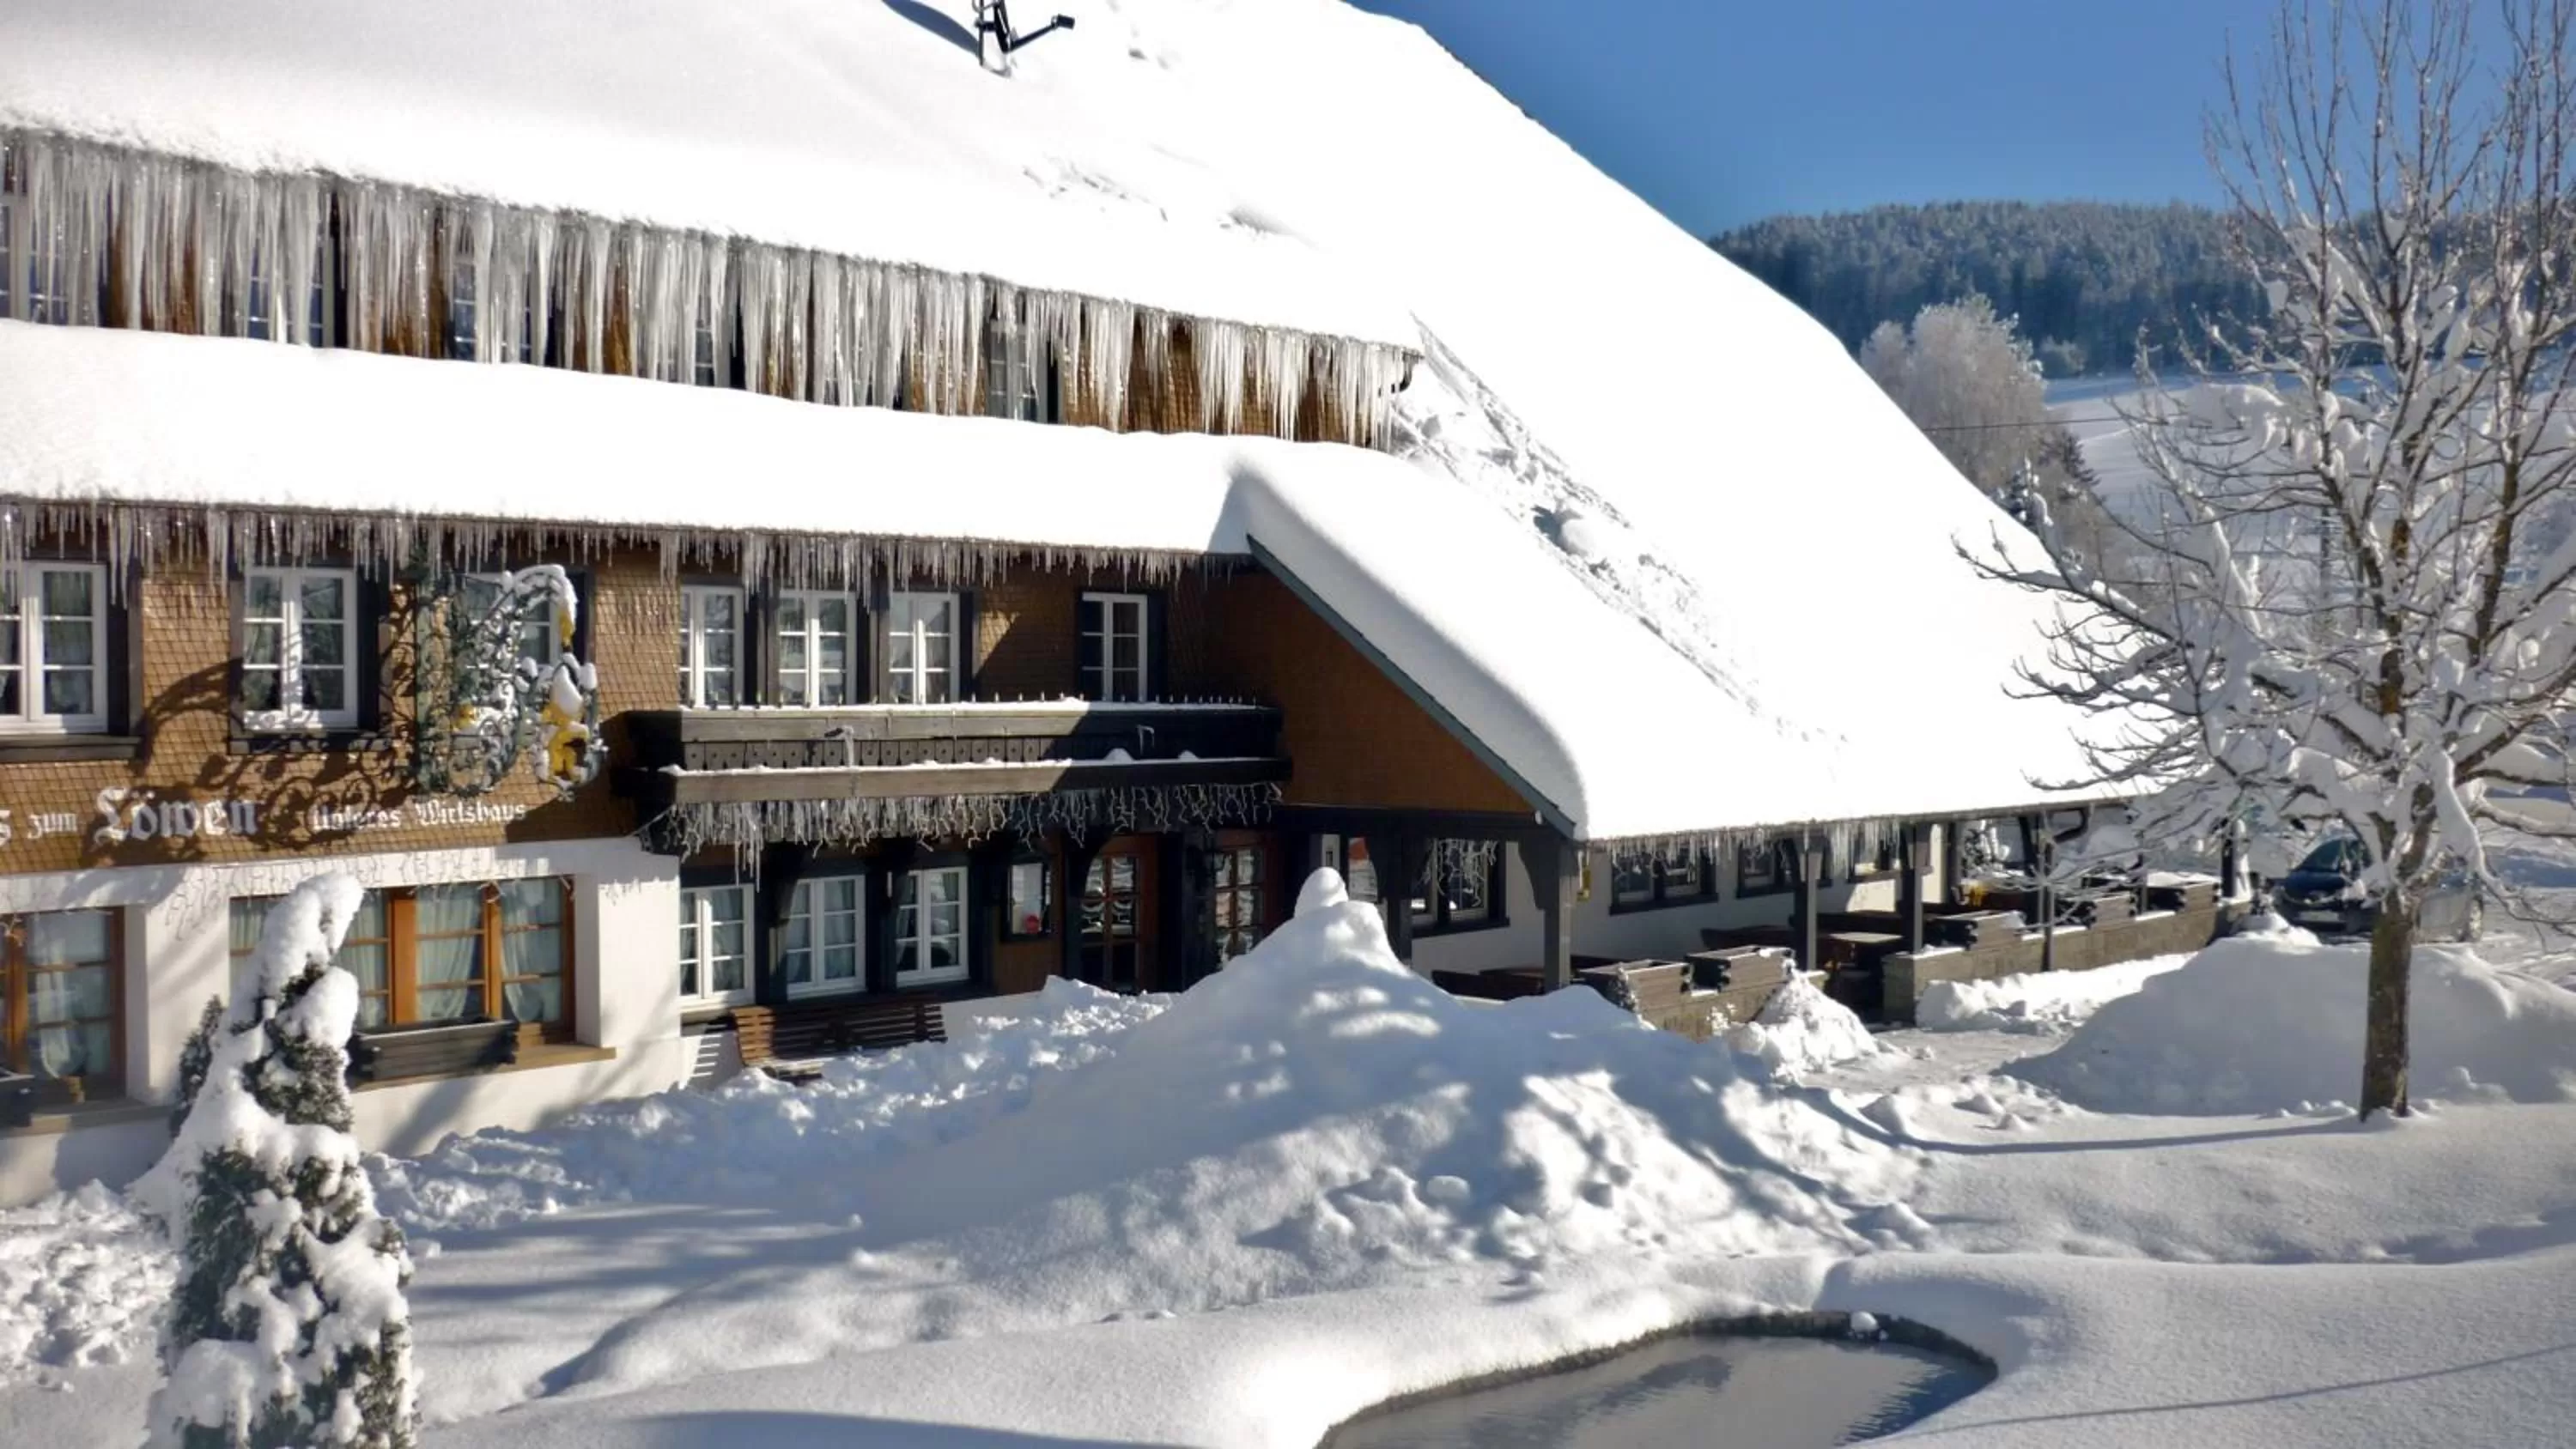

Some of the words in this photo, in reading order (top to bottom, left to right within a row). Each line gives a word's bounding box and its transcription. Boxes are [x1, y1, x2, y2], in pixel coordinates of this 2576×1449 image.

[27, 812, 78, 840] zum
[92, 785, 258, 846] Löwen
[415, 799, 526, 827] Wirtshaus
